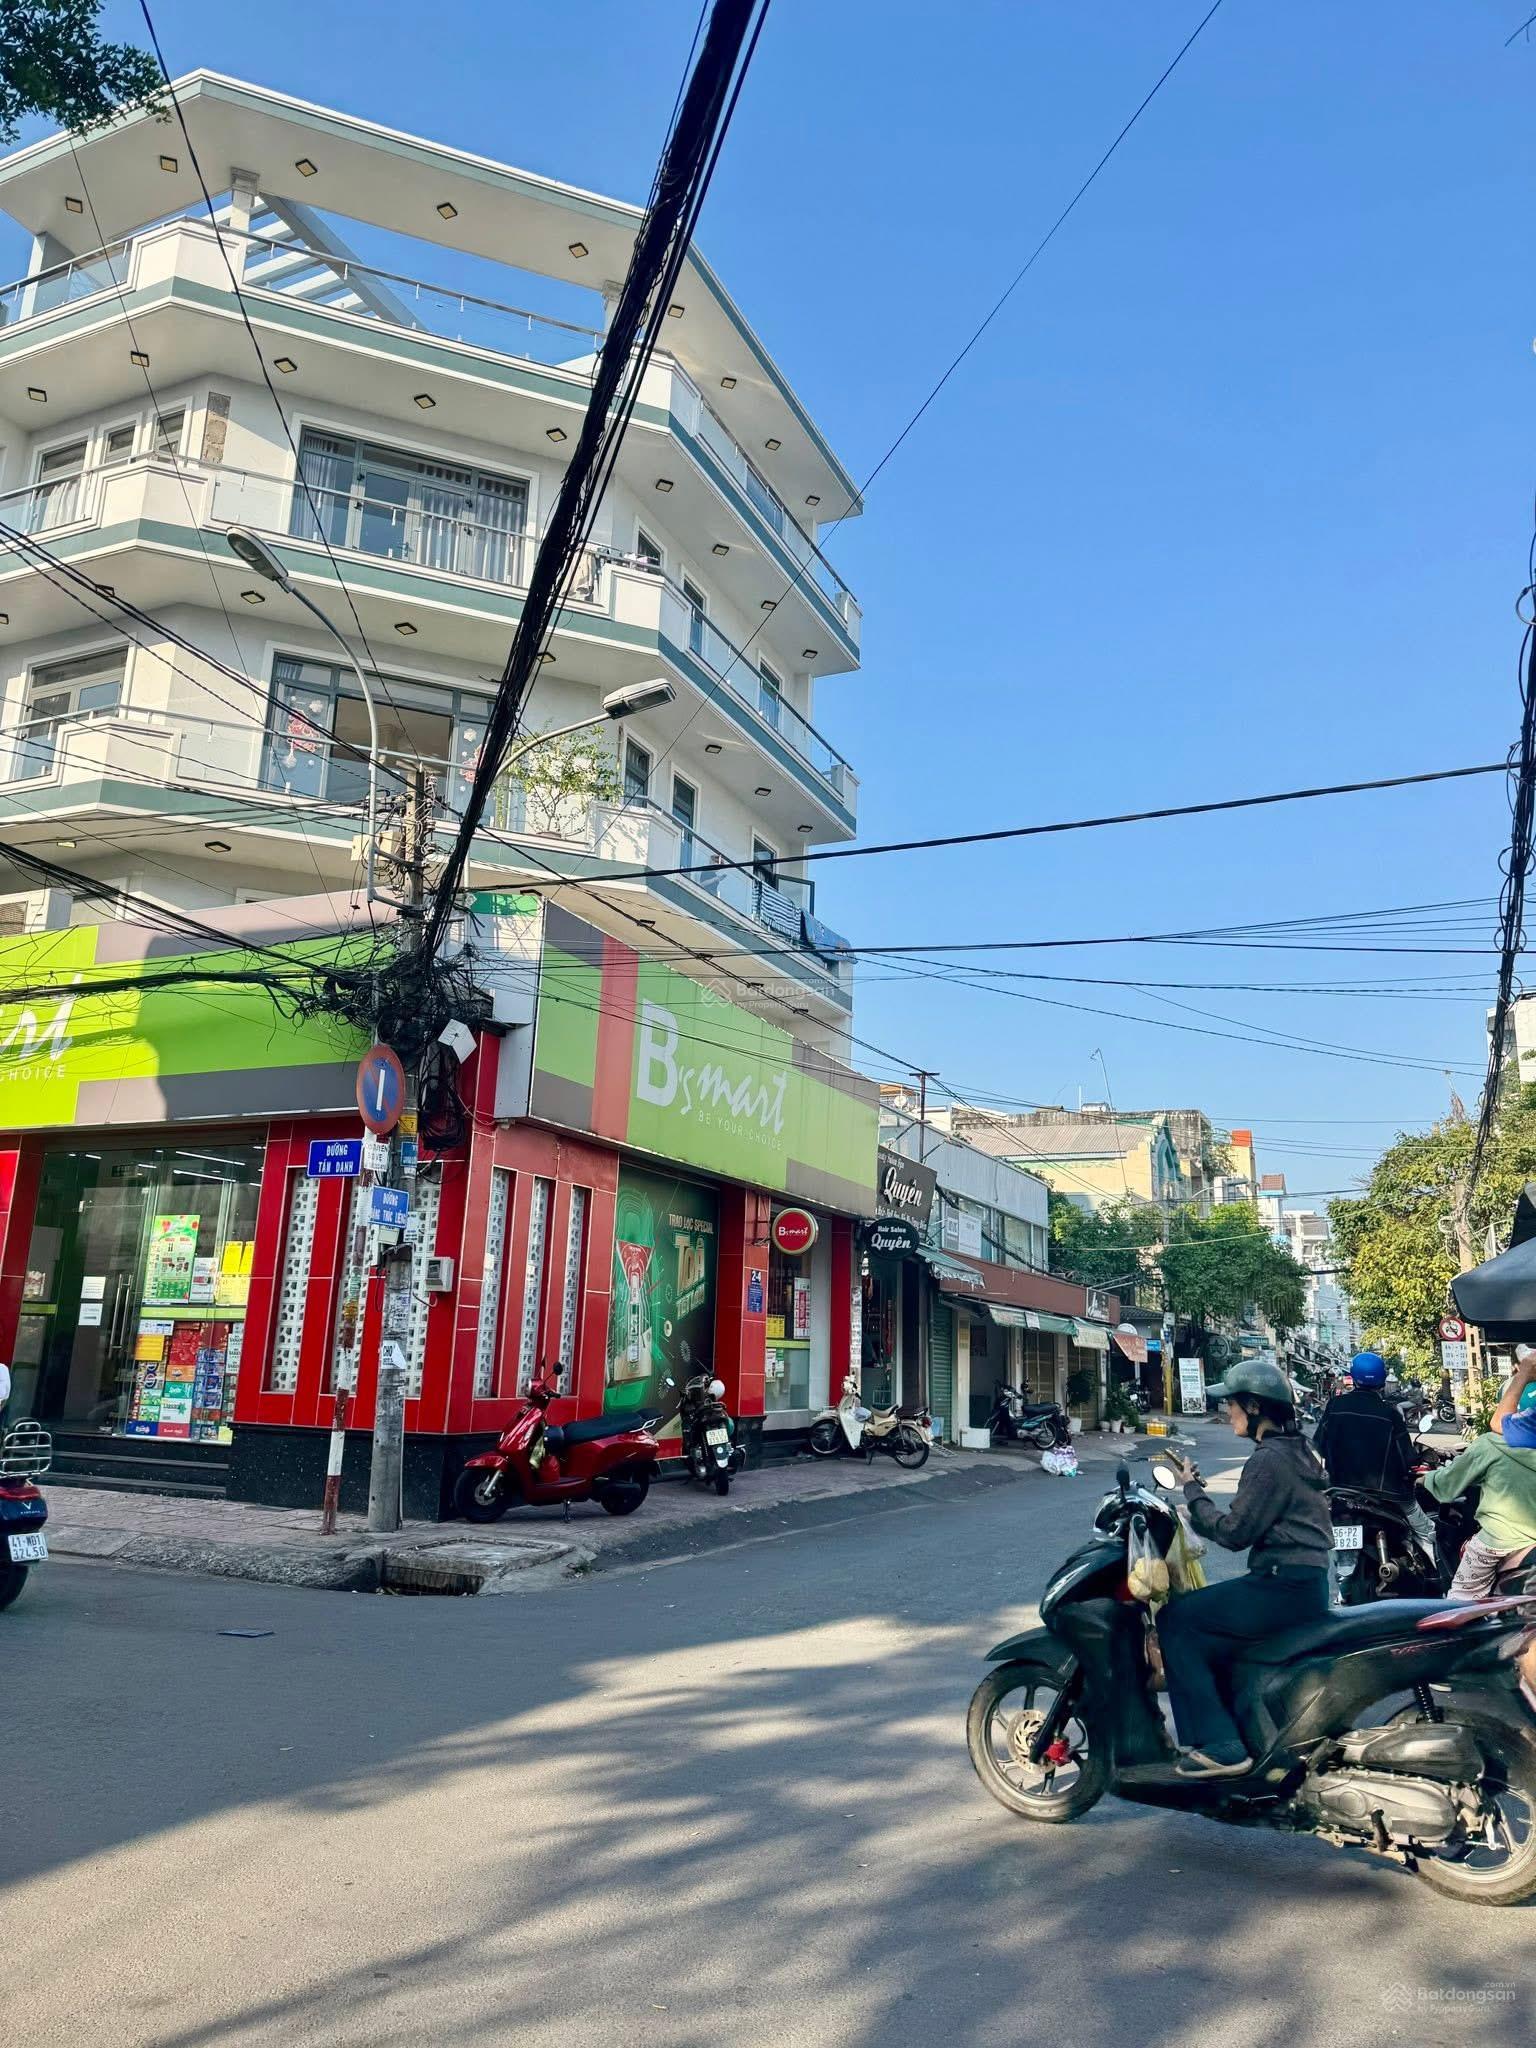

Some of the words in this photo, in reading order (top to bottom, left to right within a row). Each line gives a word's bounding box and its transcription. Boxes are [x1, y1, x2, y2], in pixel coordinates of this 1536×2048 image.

[0, 1064, 66, 1080] HOICE
[699, 1110, 711, 1125] BE
[718, 1117, 744, 1136] YOUR
[749, 1128, 782, 1151] CHOICE
[884, 1166, 923, 1208] Quyên
[871, 1233, 912, 1251] Quyên
